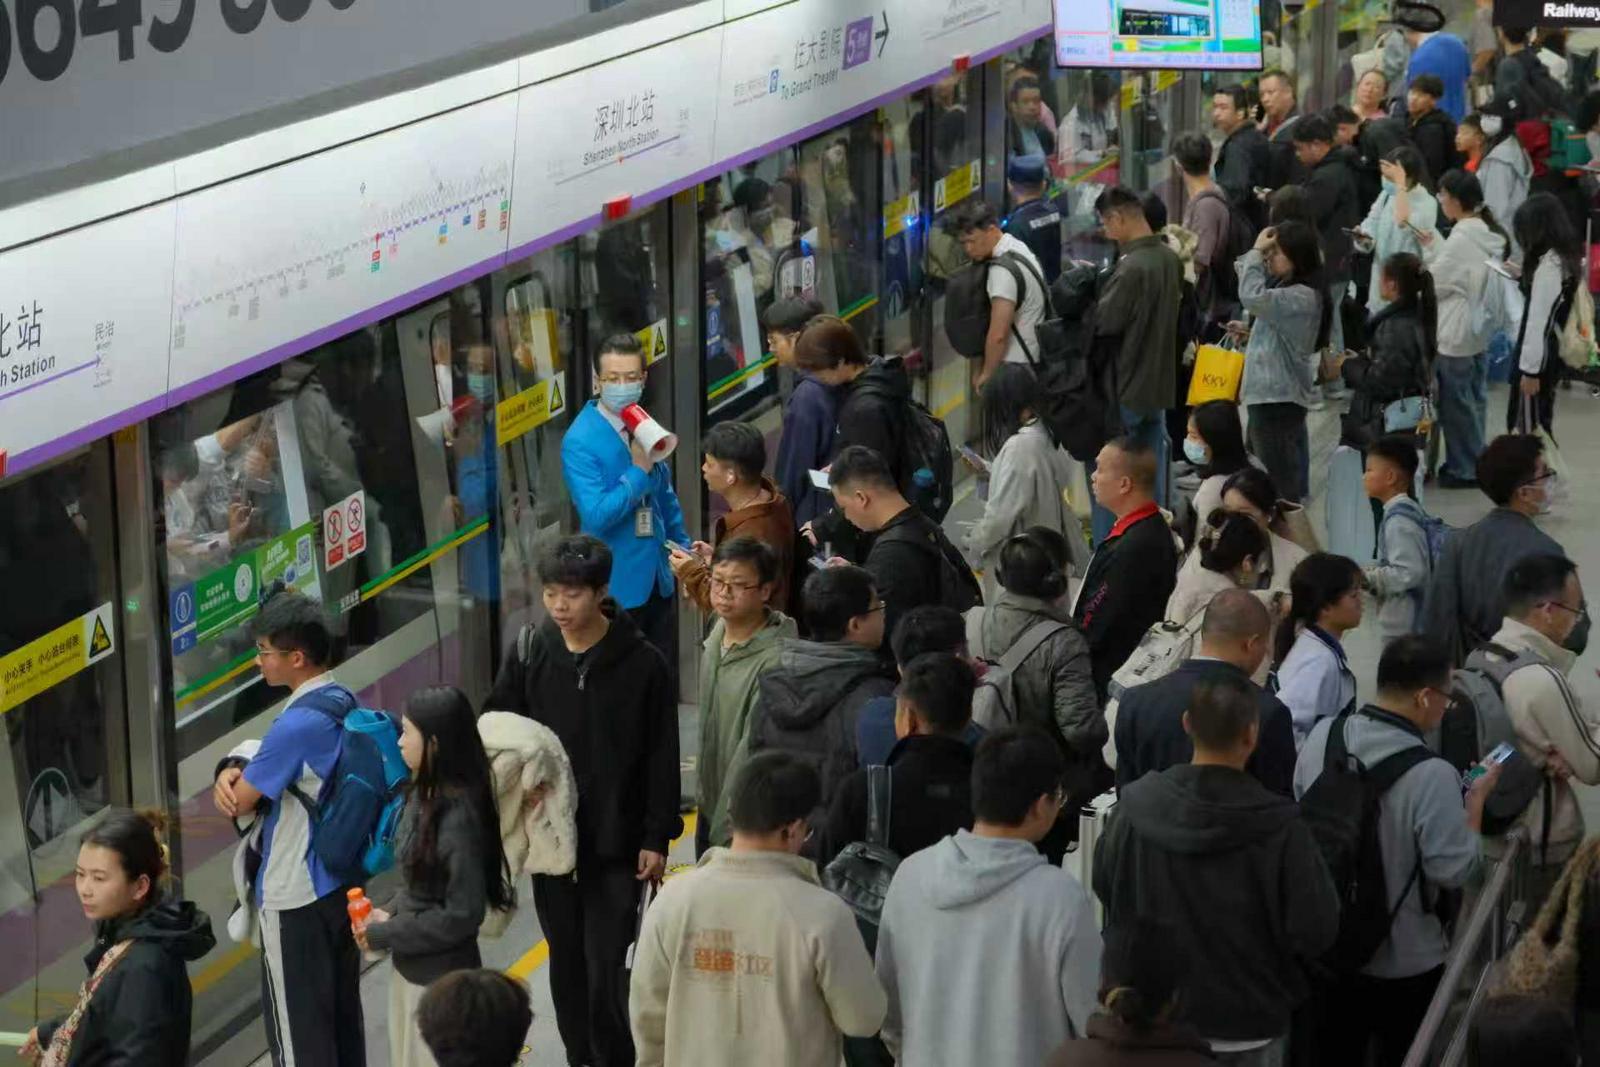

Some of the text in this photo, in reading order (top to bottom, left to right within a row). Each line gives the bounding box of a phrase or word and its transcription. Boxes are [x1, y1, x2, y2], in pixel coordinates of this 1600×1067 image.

[1543, 3, 1600, 21] Railway
[593, 88, 656, 142] 深圳北站
[583, 129, 660, 166] Shenzhen North Station
[11, 355, 55, 384] Station
